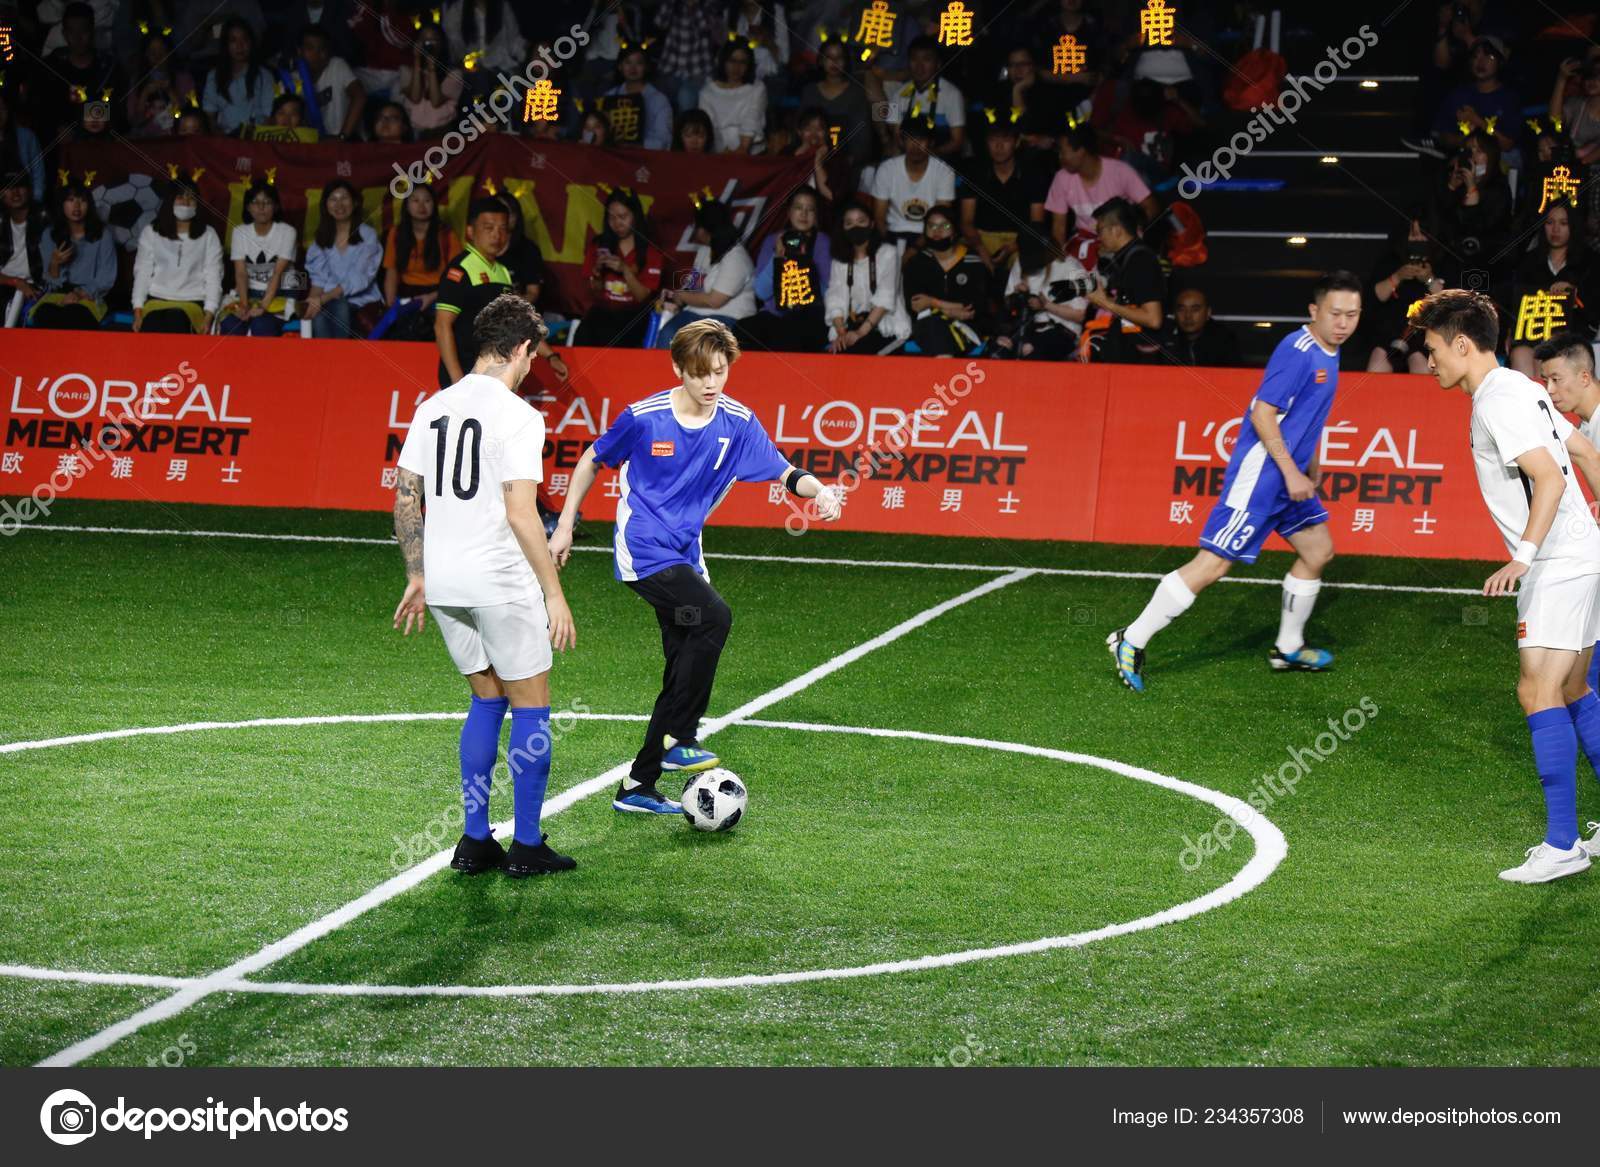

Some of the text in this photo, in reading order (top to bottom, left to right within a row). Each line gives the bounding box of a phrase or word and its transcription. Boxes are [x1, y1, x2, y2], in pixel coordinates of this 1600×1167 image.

[938, 1, 975, 46] 鹿
[1052, 34, 1088, 75] 鹿
[523, 80, 561, 122] 鹿
[779, 260, 815, 307] 鹿
[6, 418, 250, 456] MEN EXPERT
[821, 418, 857, 430] PARIS
[1, 452, 242, 483] 欧莱雅男士
[429, 415, 483, 501] 10
[713, 437, 730, 470] 7
[869, 452, 1026, 486] EXPERT
[1232, 525, 1255, 551] 3
